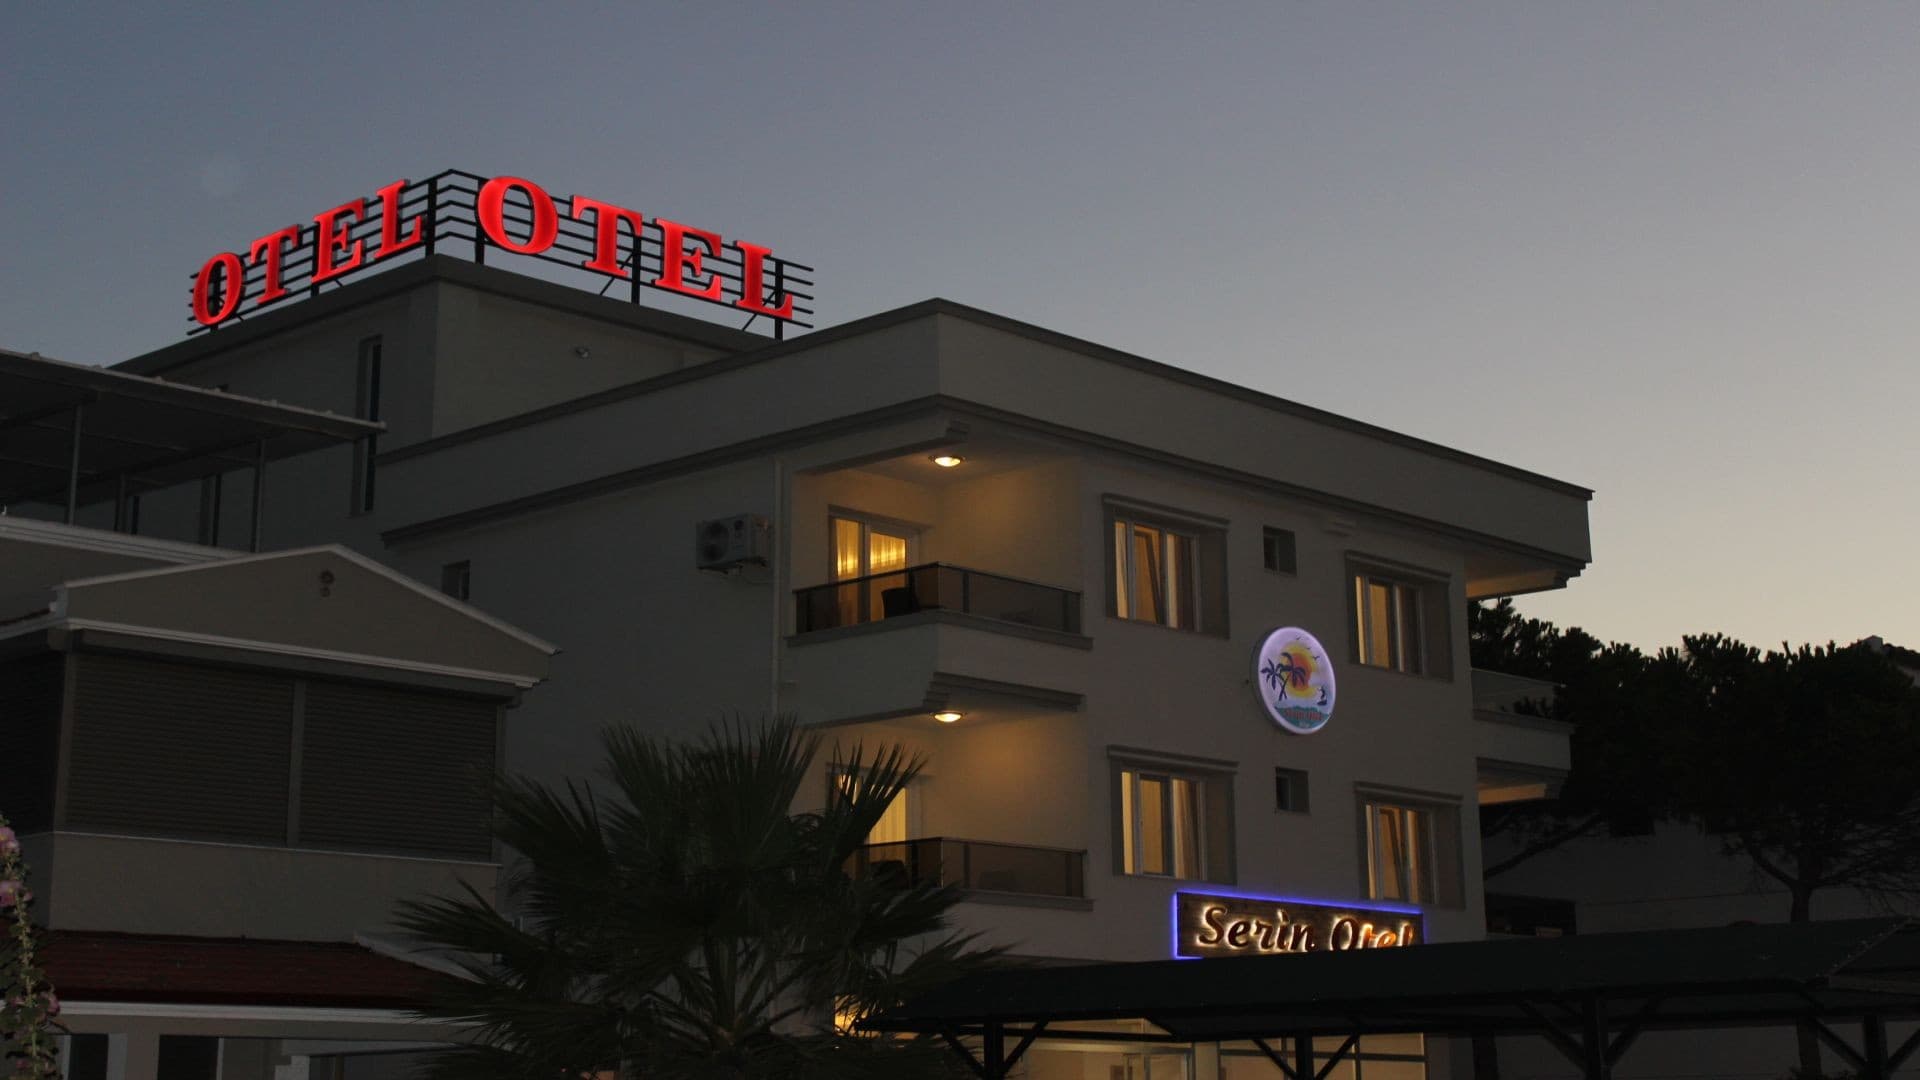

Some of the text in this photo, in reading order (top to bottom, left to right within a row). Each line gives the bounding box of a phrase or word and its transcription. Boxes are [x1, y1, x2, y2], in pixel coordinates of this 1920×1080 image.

[192, 179, 423, 326] OTEL
[477, 176, 794, 320] OTEL
[1198, 905, 1414, 952] Serin Otel
